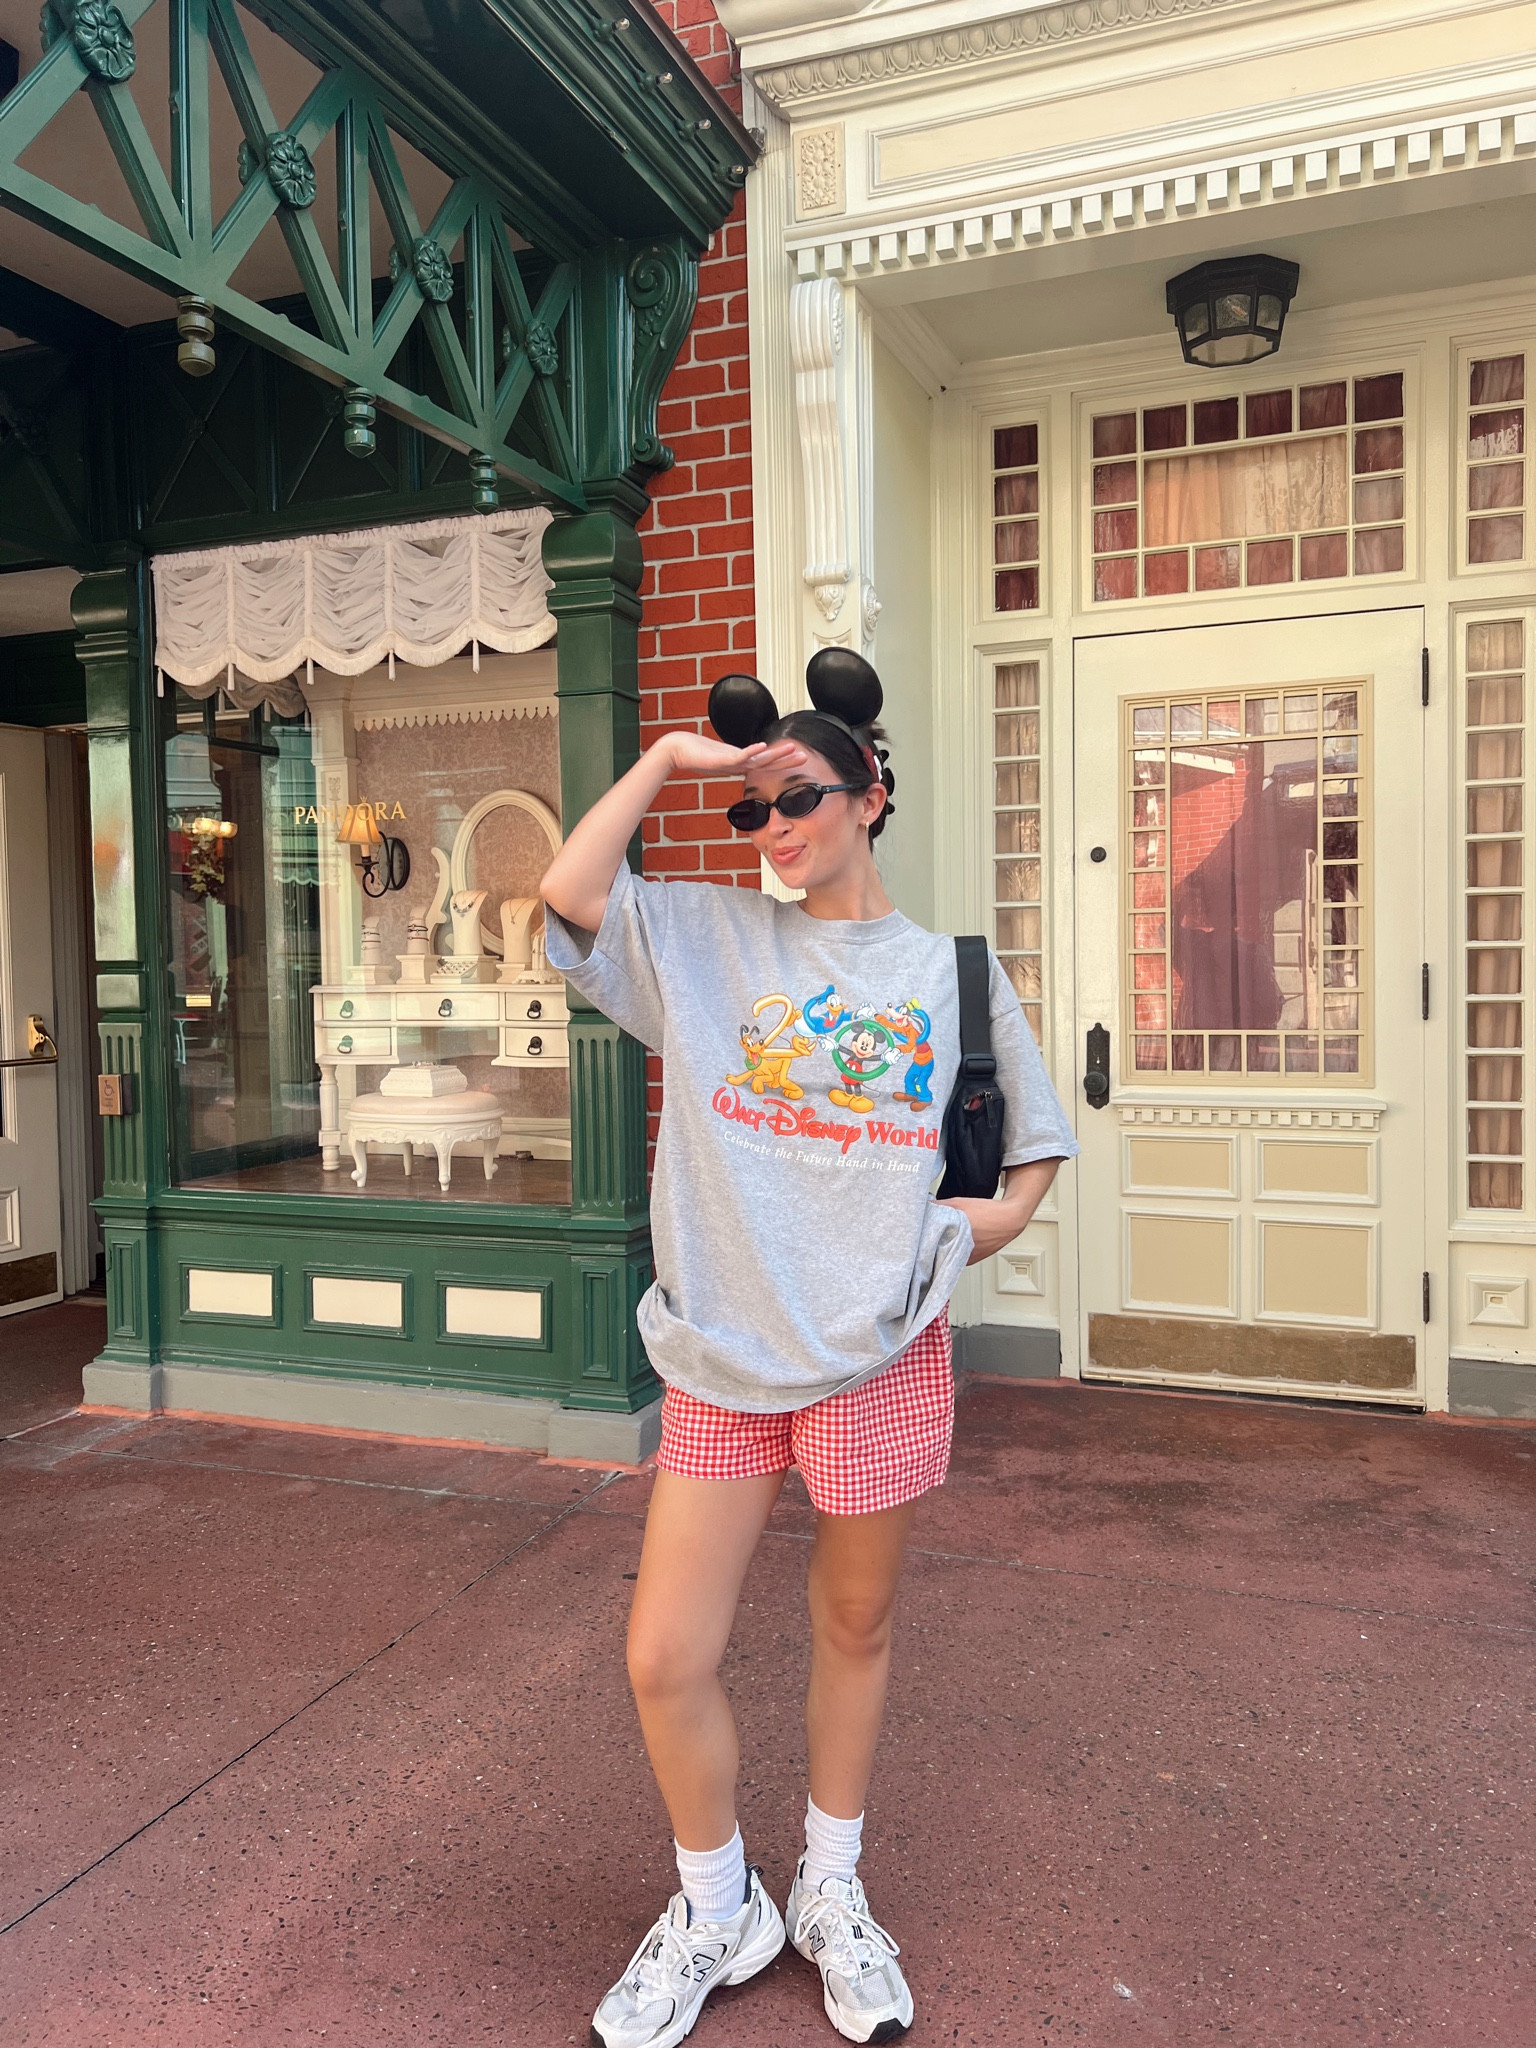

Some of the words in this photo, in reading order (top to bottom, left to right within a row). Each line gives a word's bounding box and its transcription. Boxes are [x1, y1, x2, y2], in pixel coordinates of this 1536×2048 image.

[294, 800, 407, 825] PANDORA
[865, 1120, 938, 1150] World
[724, 1130, 771, 1156] Celebrate
[774, 1147, 793, 1160] the
[795, 1150, 833, 1166] Future
[836, 1155, 868, 1171] Hand
[871, 1157, 884, 1170] in
[887, 1160, 921, 1174] Hand
